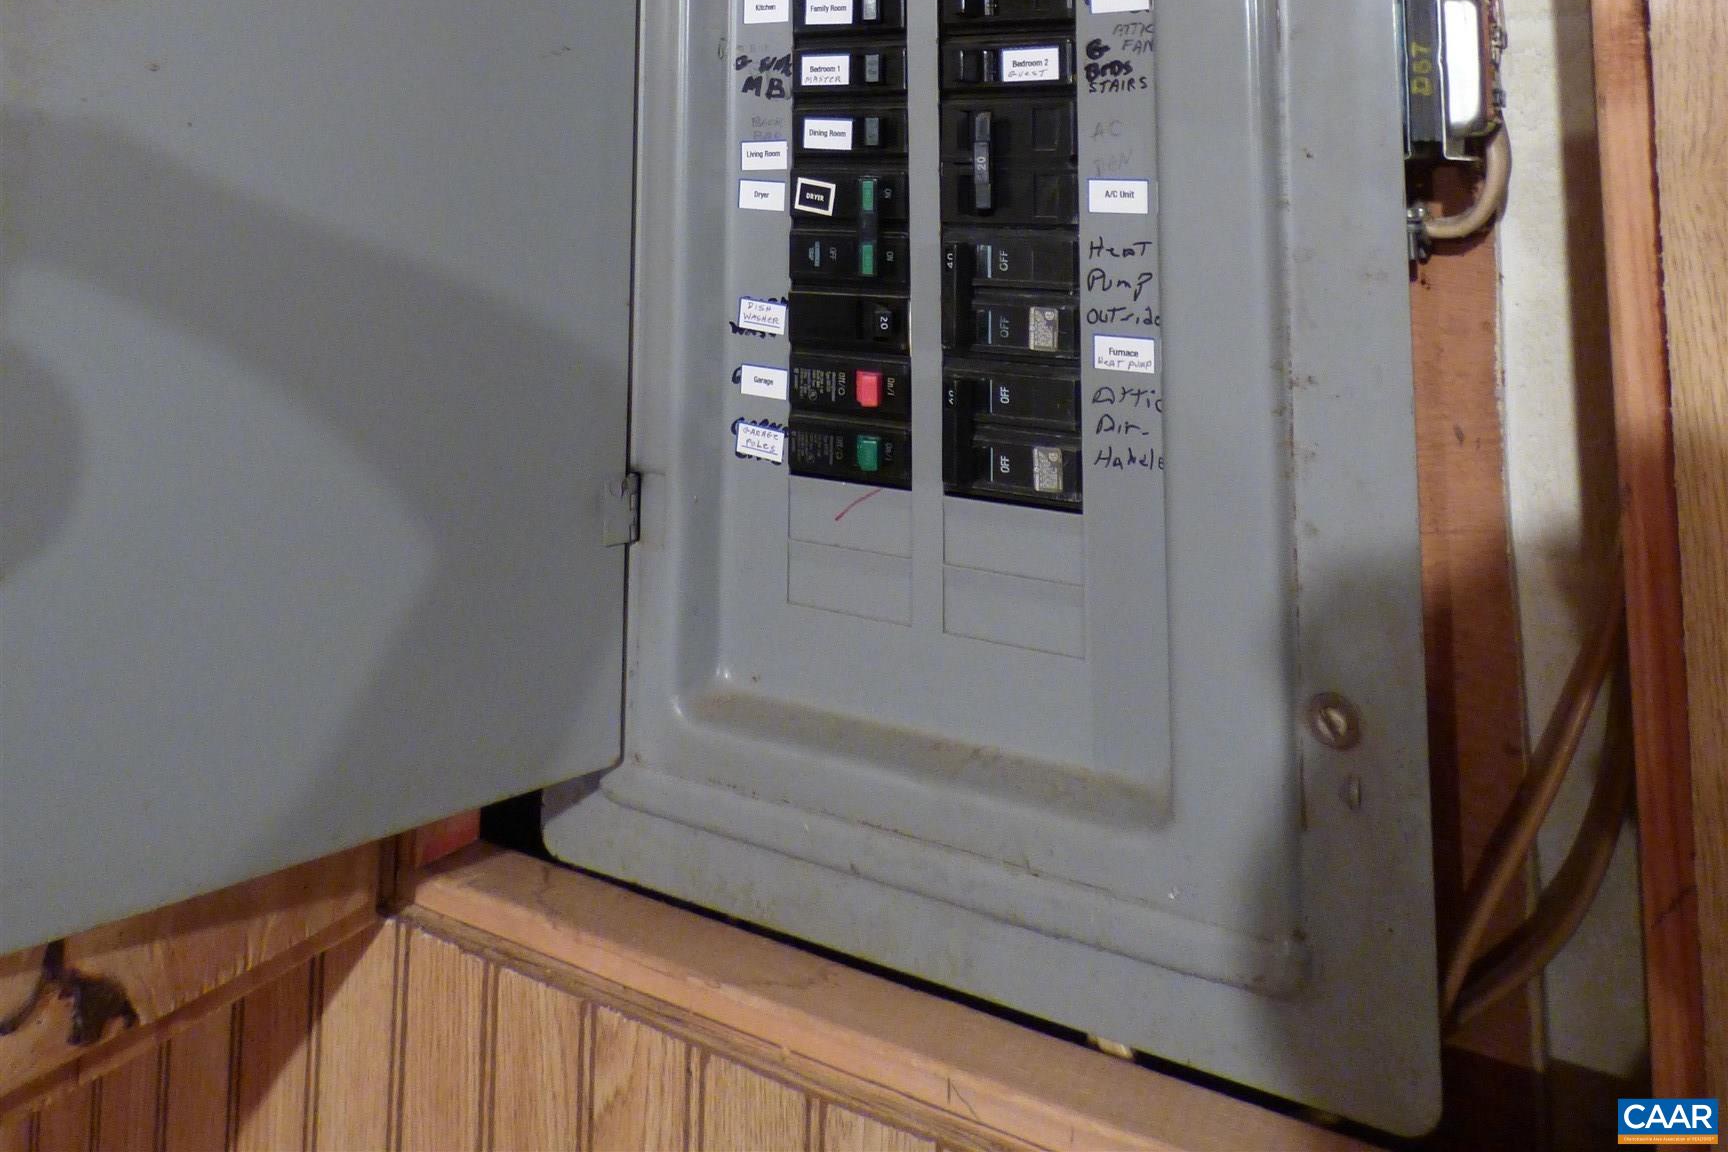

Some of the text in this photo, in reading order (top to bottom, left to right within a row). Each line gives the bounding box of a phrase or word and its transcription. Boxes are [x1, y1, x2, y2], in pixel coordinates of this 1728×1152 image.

[755, 3, 777, 12] Kitchen
[810, 4, 847, 13] Family Room
[809, 65, 836, 74] Bedroom
[1012, 59, 1043, 69] Bedroom
[1088, 76, 1149, 94] STAIRS
[809, 128, 847, 138] Dining Room
[746, 150, 781, 160] Living Room
[976, 156, 987, 171] 20
[753, 190, 770, 200] Dryer
[805, 191, 825, 203] DRYER
[1104, 189, 1135, 200] A/C Unit
[999, 249, 1009, 272] OFF
[880, 315, 888, 331] 20
[1000, 317, 1010, 338] OFF
[1108, 346, 1139, 358] Furnace
[753, 375, 774, 386] Garage
[999, 385, 1010, 405] OFF
[1000, 455, 1011, 474] OFF
